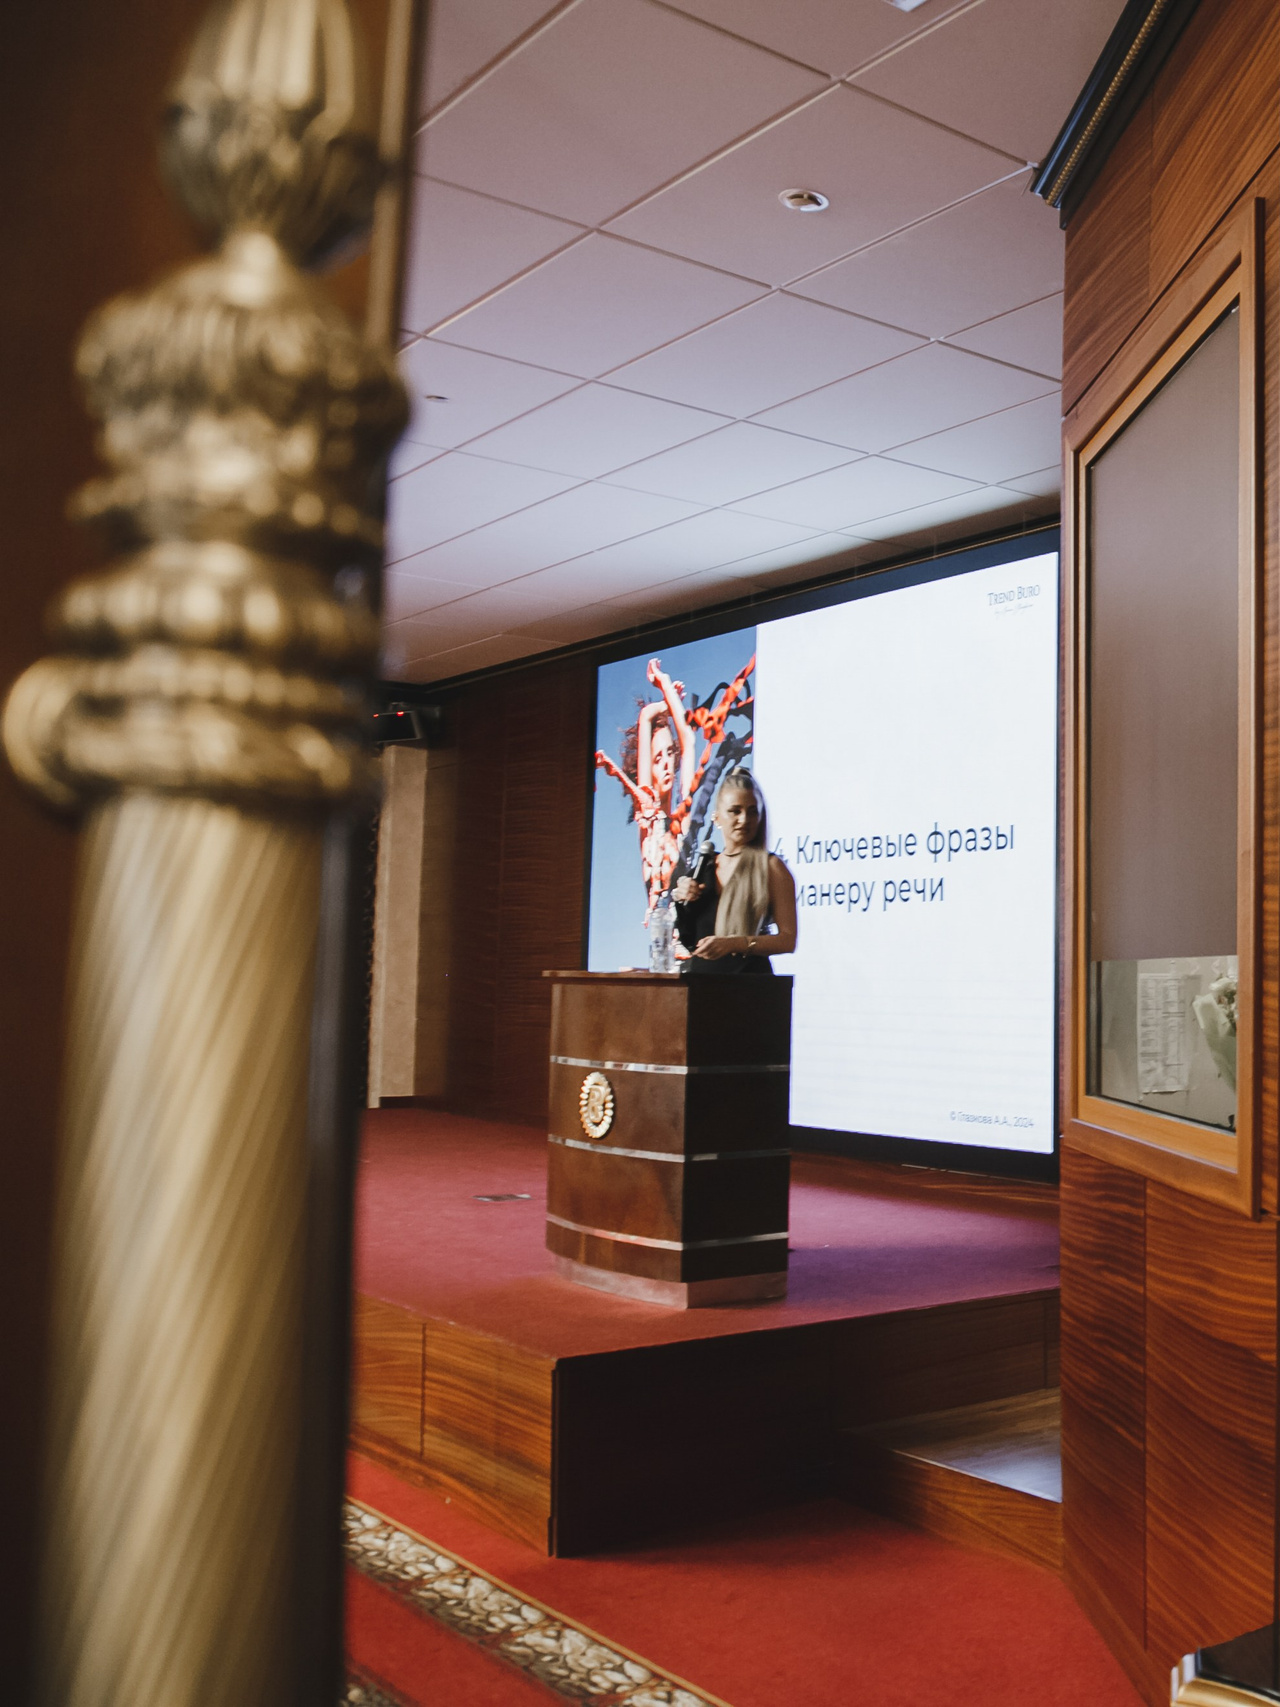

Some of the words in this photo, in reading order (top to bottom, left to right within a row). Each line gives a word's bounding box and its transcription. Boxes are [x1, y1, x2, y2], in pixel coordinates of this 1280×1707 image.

[796, 833, 918, 865] Ключевые
[926, 822, 1015, 864] фразы
[883, 877, 945, 912] речи
